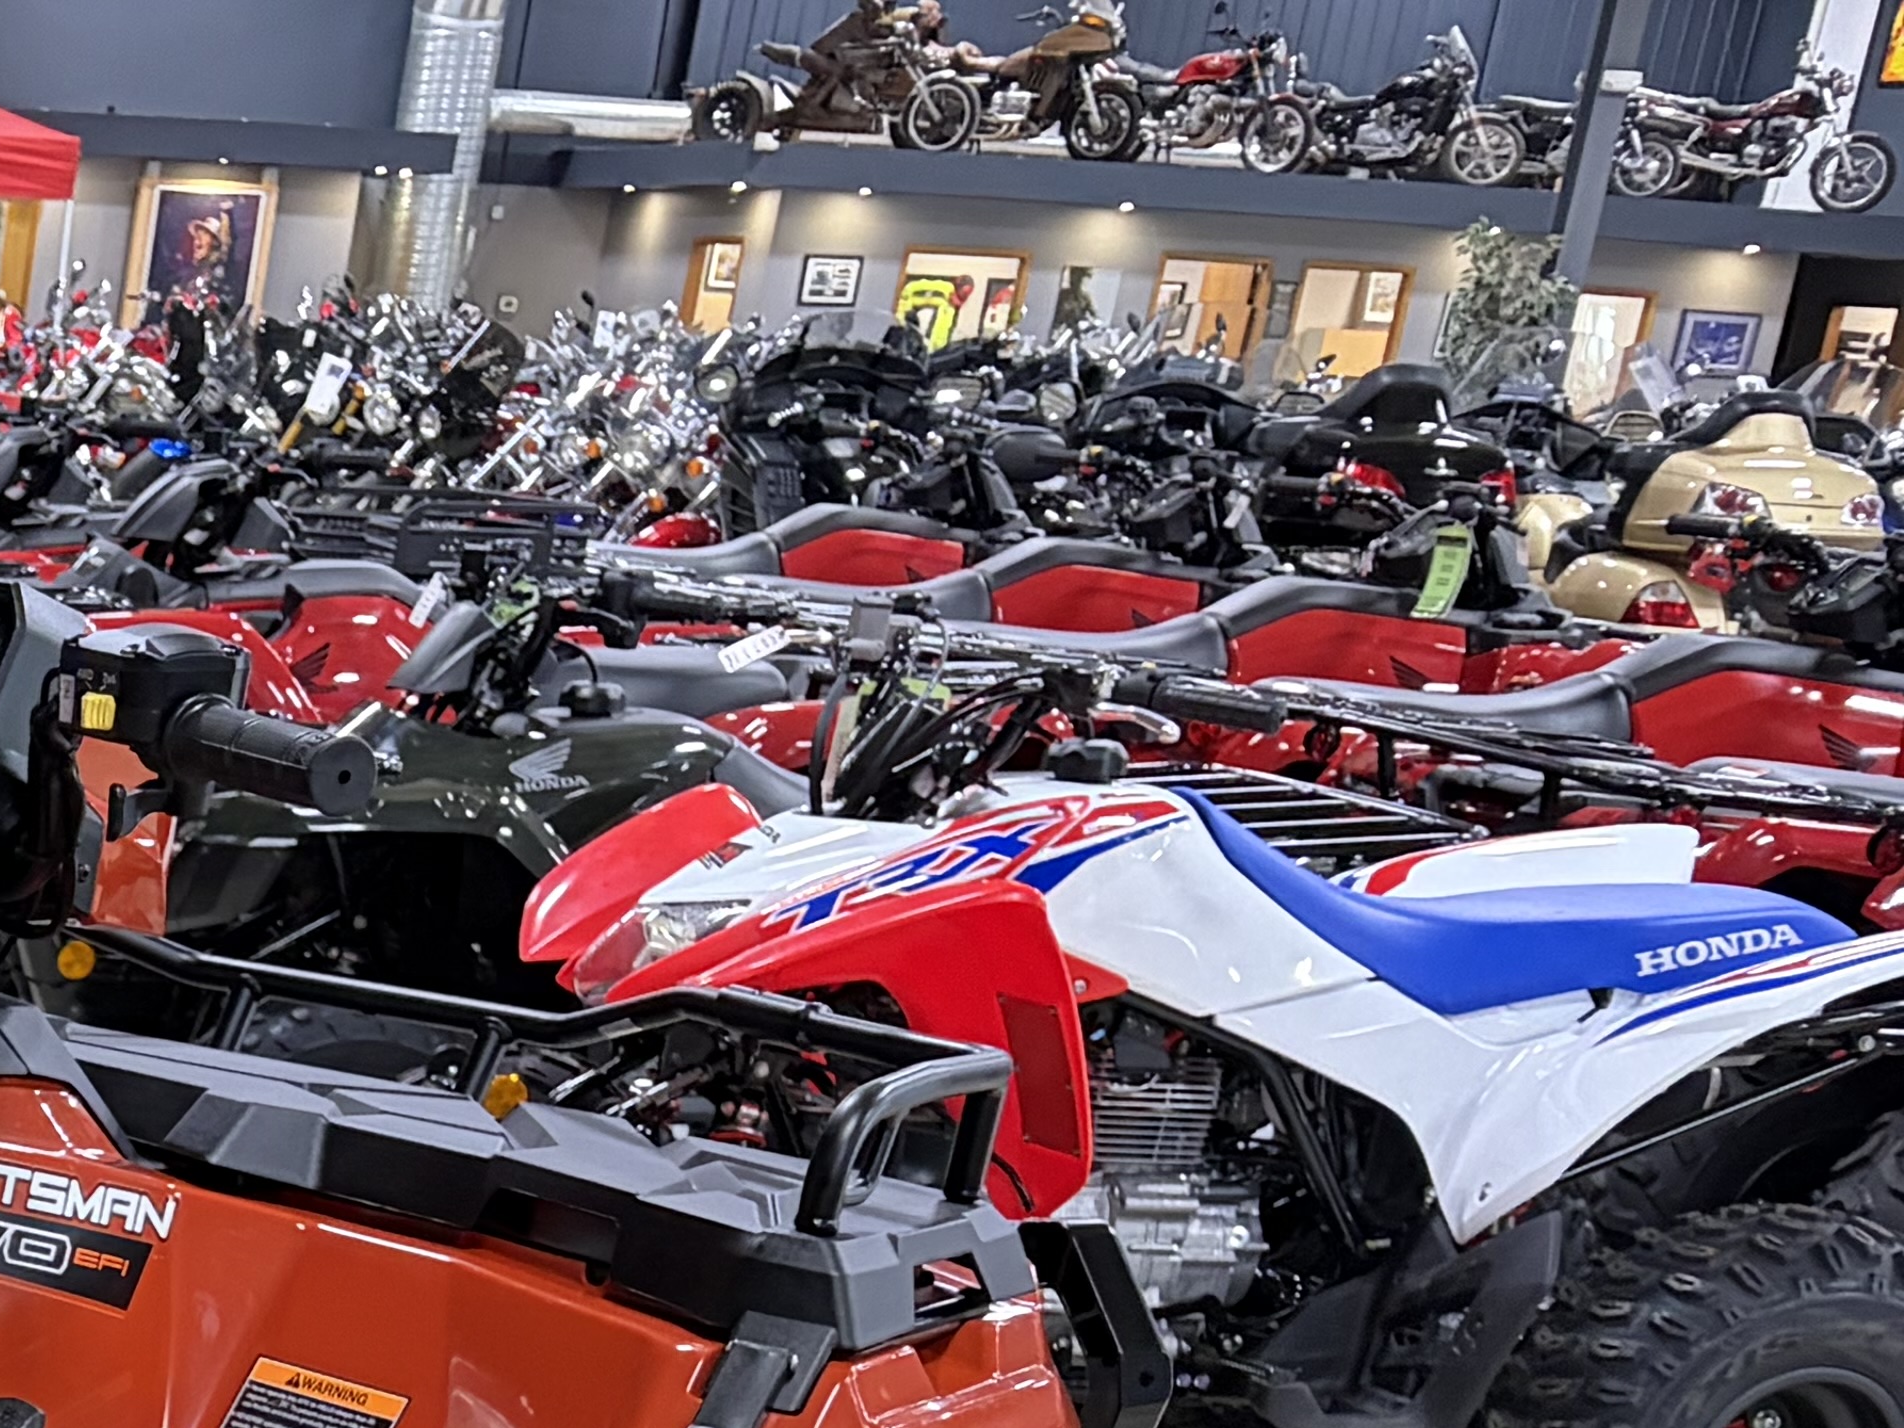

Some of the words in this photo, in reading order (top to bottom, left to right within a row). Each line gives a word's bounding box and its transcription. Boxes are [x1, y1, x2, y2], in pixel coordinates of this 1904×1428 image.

[513, 774, 591, 793] HONDA
[1634, 923, 1804, 978] HONDA
[72, 1247, 130, 1278] EFI
[301, 1374, 369, 1407] WARNING
